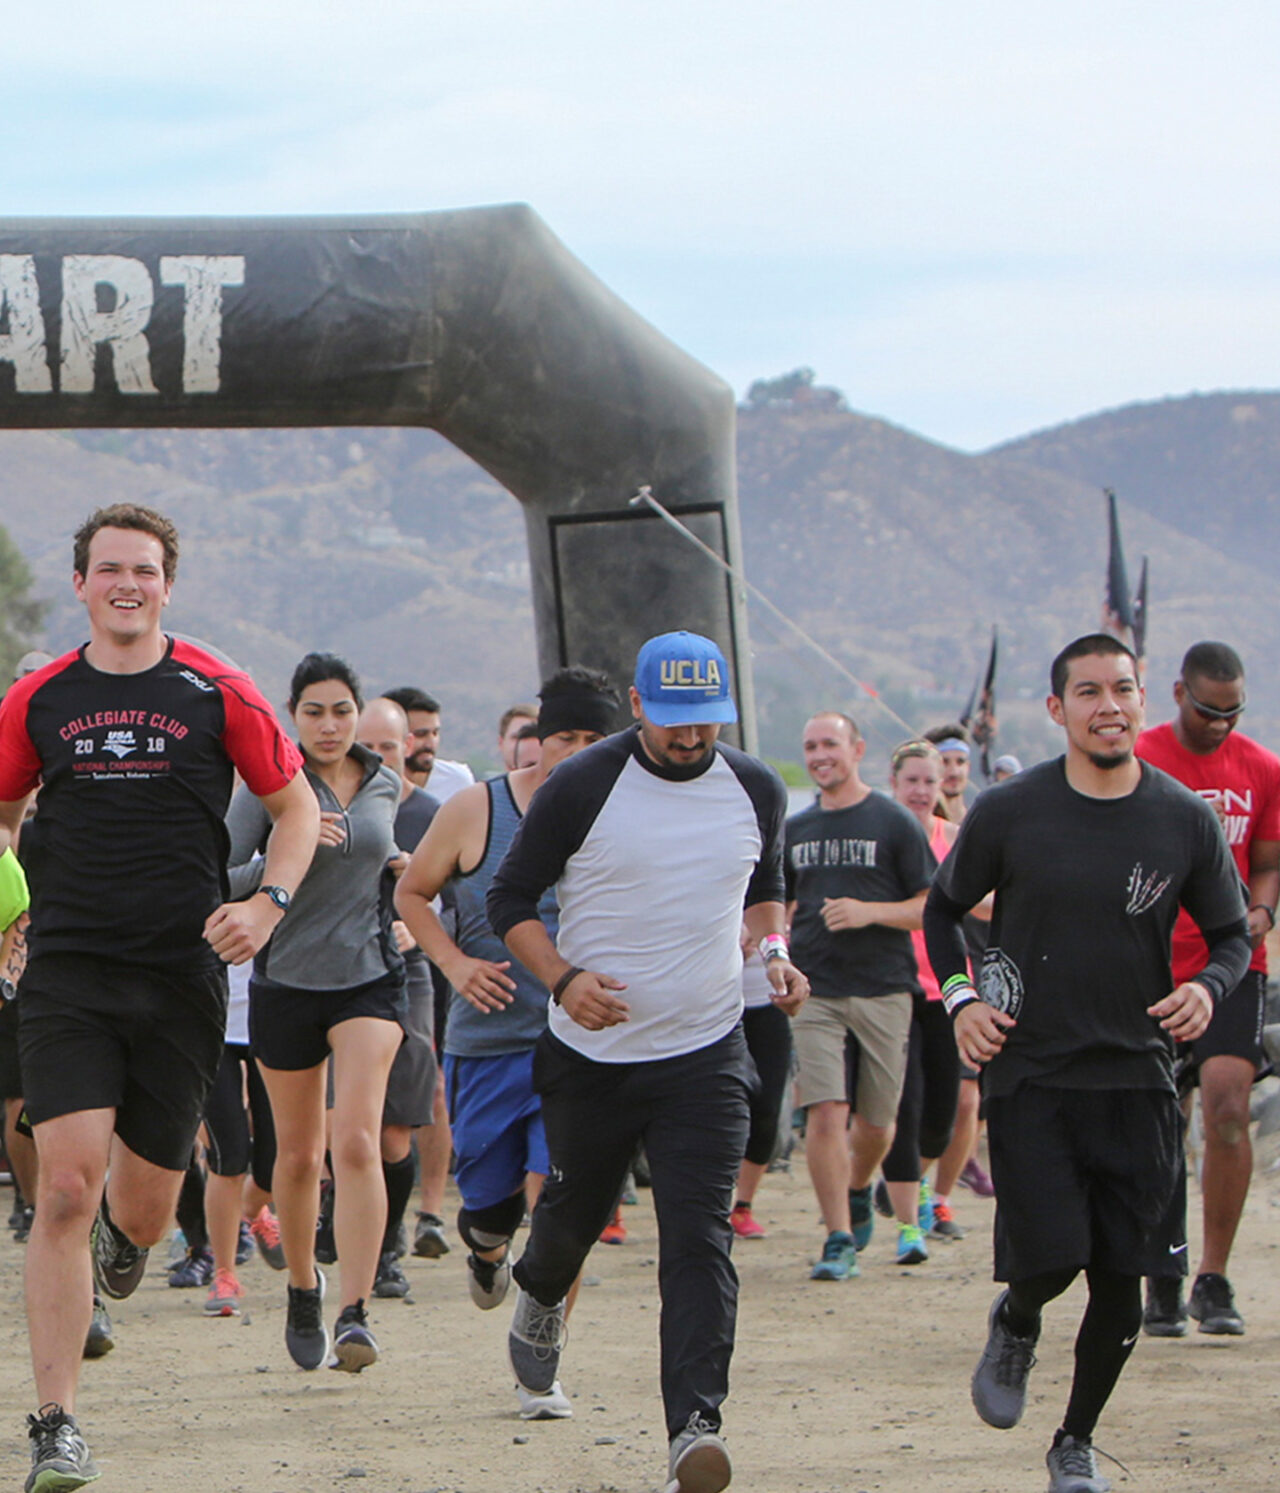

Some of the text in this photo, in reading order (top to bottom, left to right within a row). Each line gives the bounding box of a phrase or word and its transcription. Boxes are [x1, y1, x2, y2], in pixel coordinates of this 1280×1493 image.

[179, 670, 214, 692] 2XU
[661, 659, 721, 684] UCLA
[59, 710, 189, 741] COLLEGIATE CLUB
[107, 730, 134, 740] USA
[75, 737, 166, 755] 20 18
